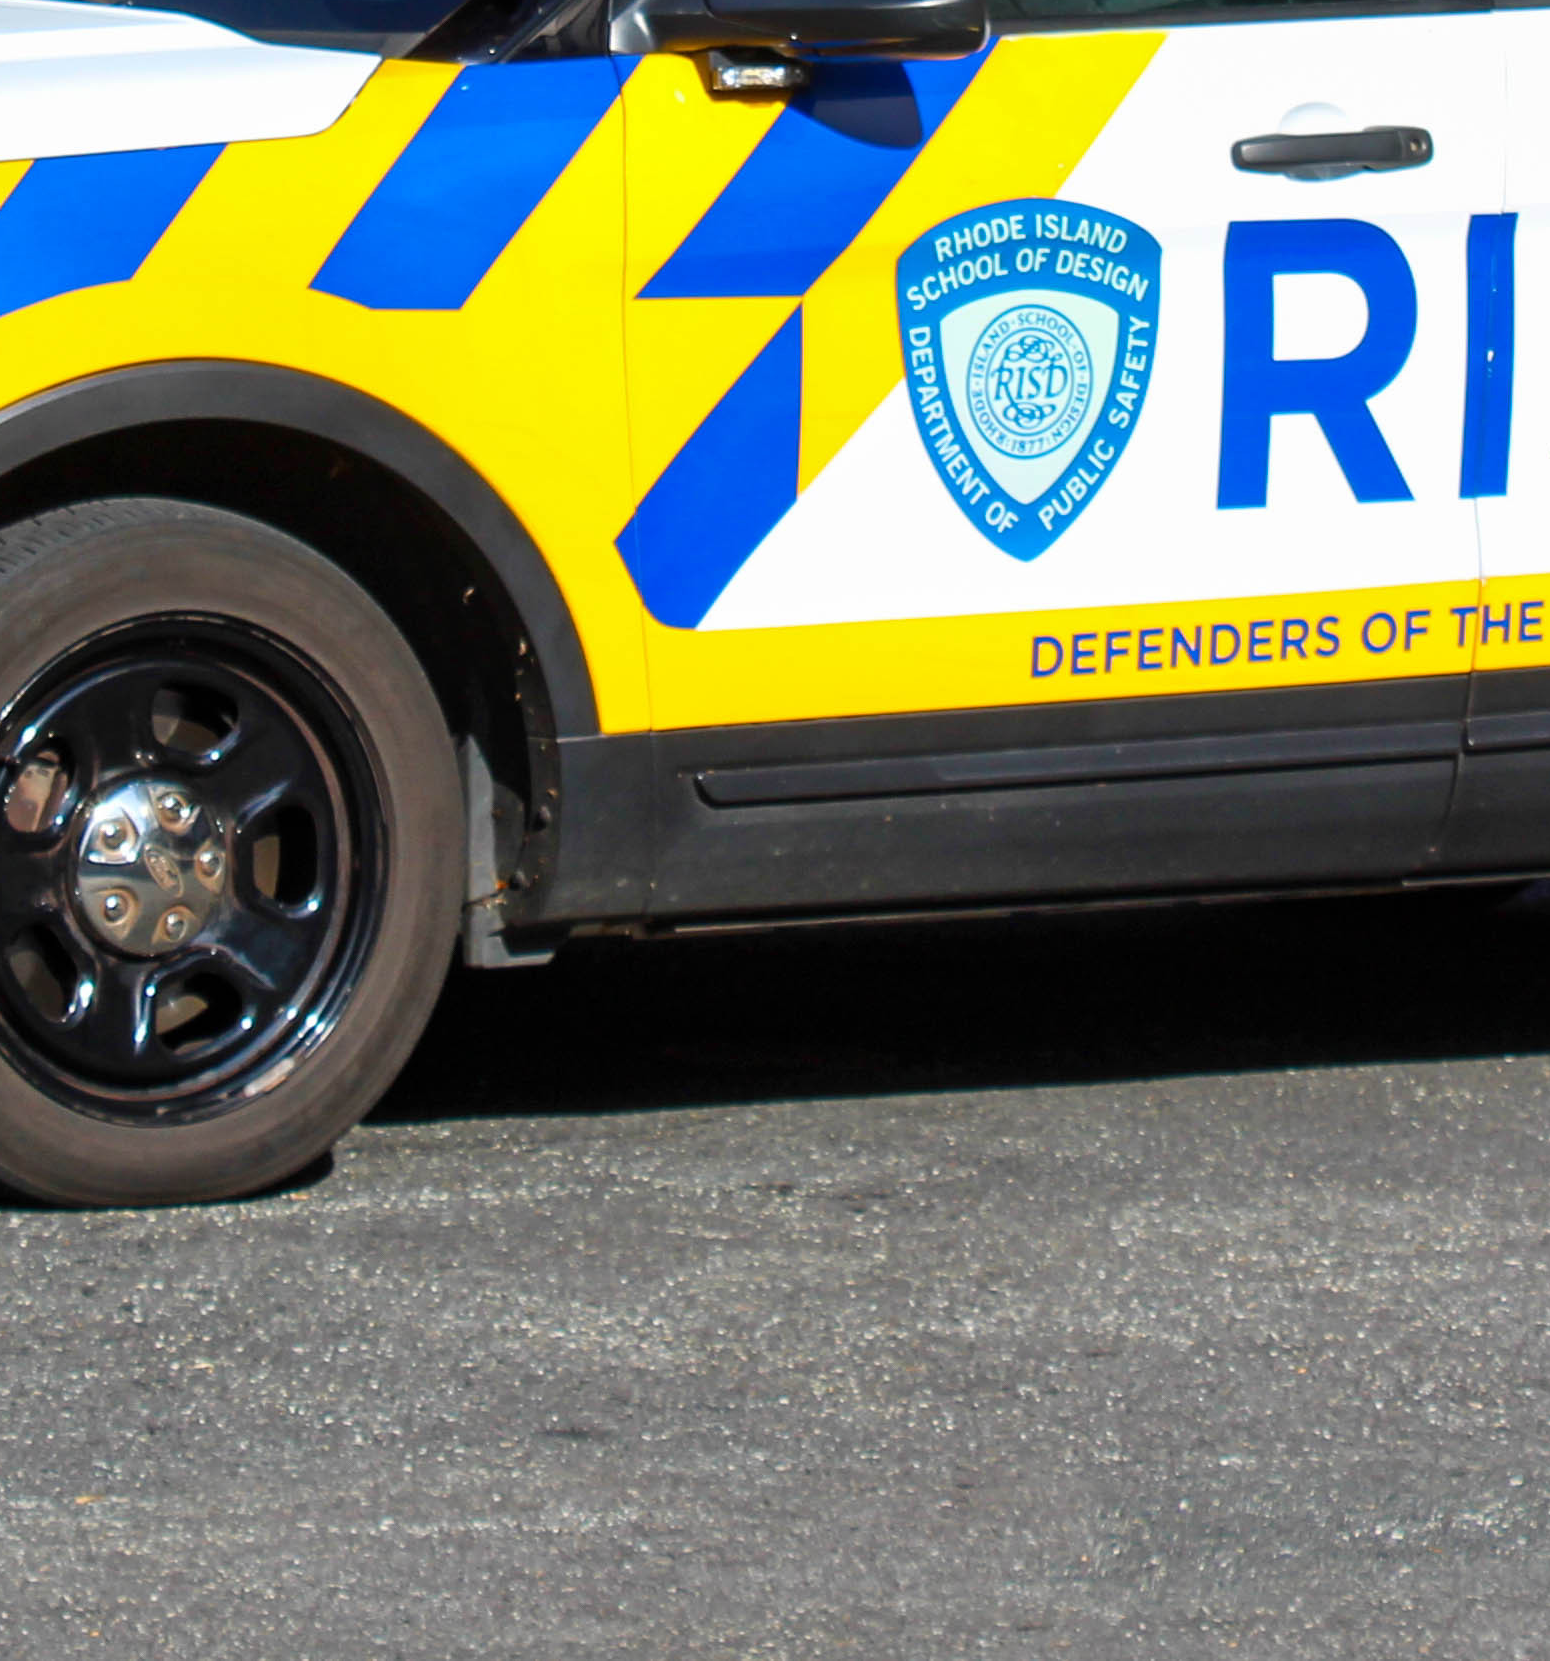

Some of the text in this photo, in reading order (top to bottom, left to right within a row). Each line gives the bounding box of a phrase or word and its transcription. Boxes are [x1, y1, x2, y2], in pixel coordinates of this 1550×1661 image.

[934, 214, 1128, 262] RHODE ISLAND
[907, 247, 1149, 311] SCHOOL OF DESIGN
[1017, 312, 1075, 345] SCHOOL
[991, 364, 1068, 401] RISD
[909, 316, 1150, 533] DEPARTMENT OF PUBLIC SAFETY
[1030, 616, 1340, 678] DEFENDERS
[1362, 610, 1431, 653] OF
[1450, 600, 1543, 647] THE
